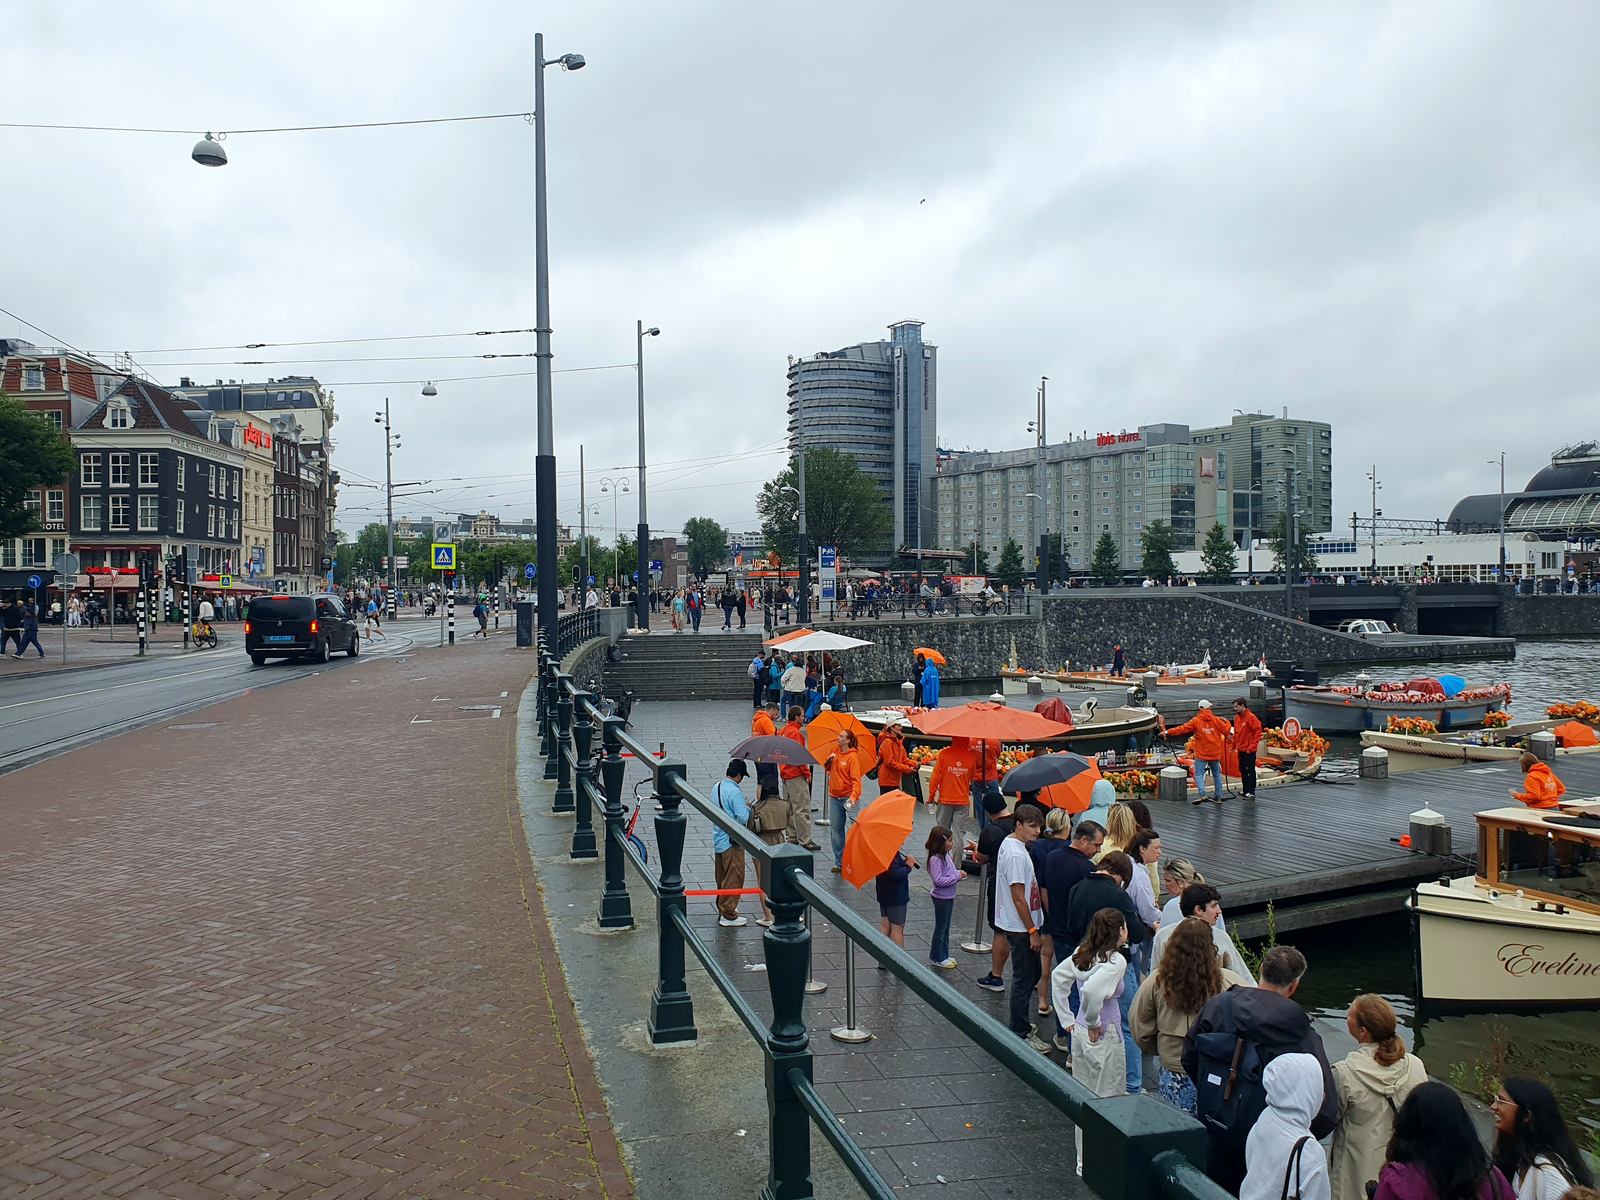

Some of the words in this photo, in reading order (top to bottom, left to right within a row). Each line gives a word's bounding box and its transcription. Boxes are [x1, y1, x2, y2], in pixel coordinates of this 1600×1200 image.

[1097, 432, 1116, 447] ibis
[1118, 433, 1141, 443] HOTEL
[648, 561, 654, 569] P
[1069, 683, 1096, 691] GLADIATOR
[1001, 743, 1030, 753] boat
[1406, 740, 1422, 748] VIBE
[1496, 943, 1600, 977] Eveline
